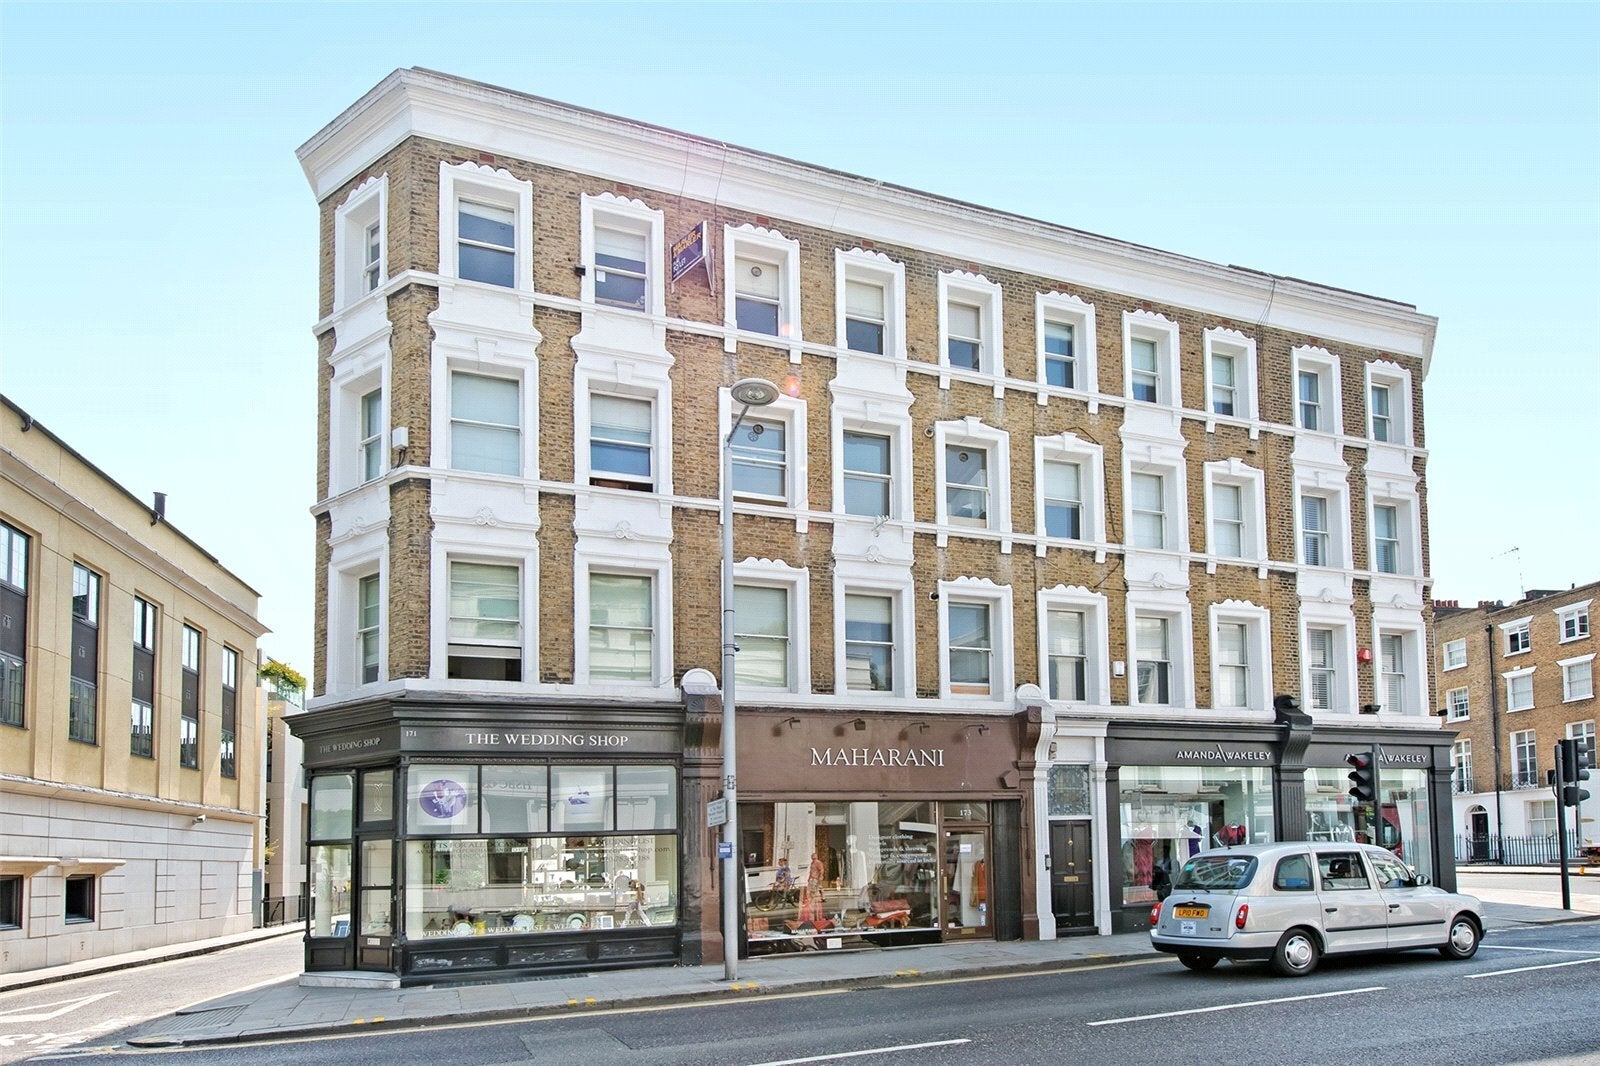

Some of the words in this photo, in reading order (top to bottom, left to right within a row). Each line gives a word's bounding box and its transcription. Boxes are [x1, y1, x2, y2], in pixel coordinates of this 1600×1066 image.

[320, 745, 331, 753] THE
[332, 740, 363, 751] WEDDING
[363, 737, 381, 747] SHOP
[465, 733, 499, 745] THE
[504, 733, 584, 746] WEDDING
[589, 735, 629, 746] SHOP
[810, 747, 945, 767] MAHARANI
[1176, 750, 1222, 759] AMANDA
[1225, 751, 1271, 760] WAKELEY
[1387, 754, 1427, 763] WAKELEY
